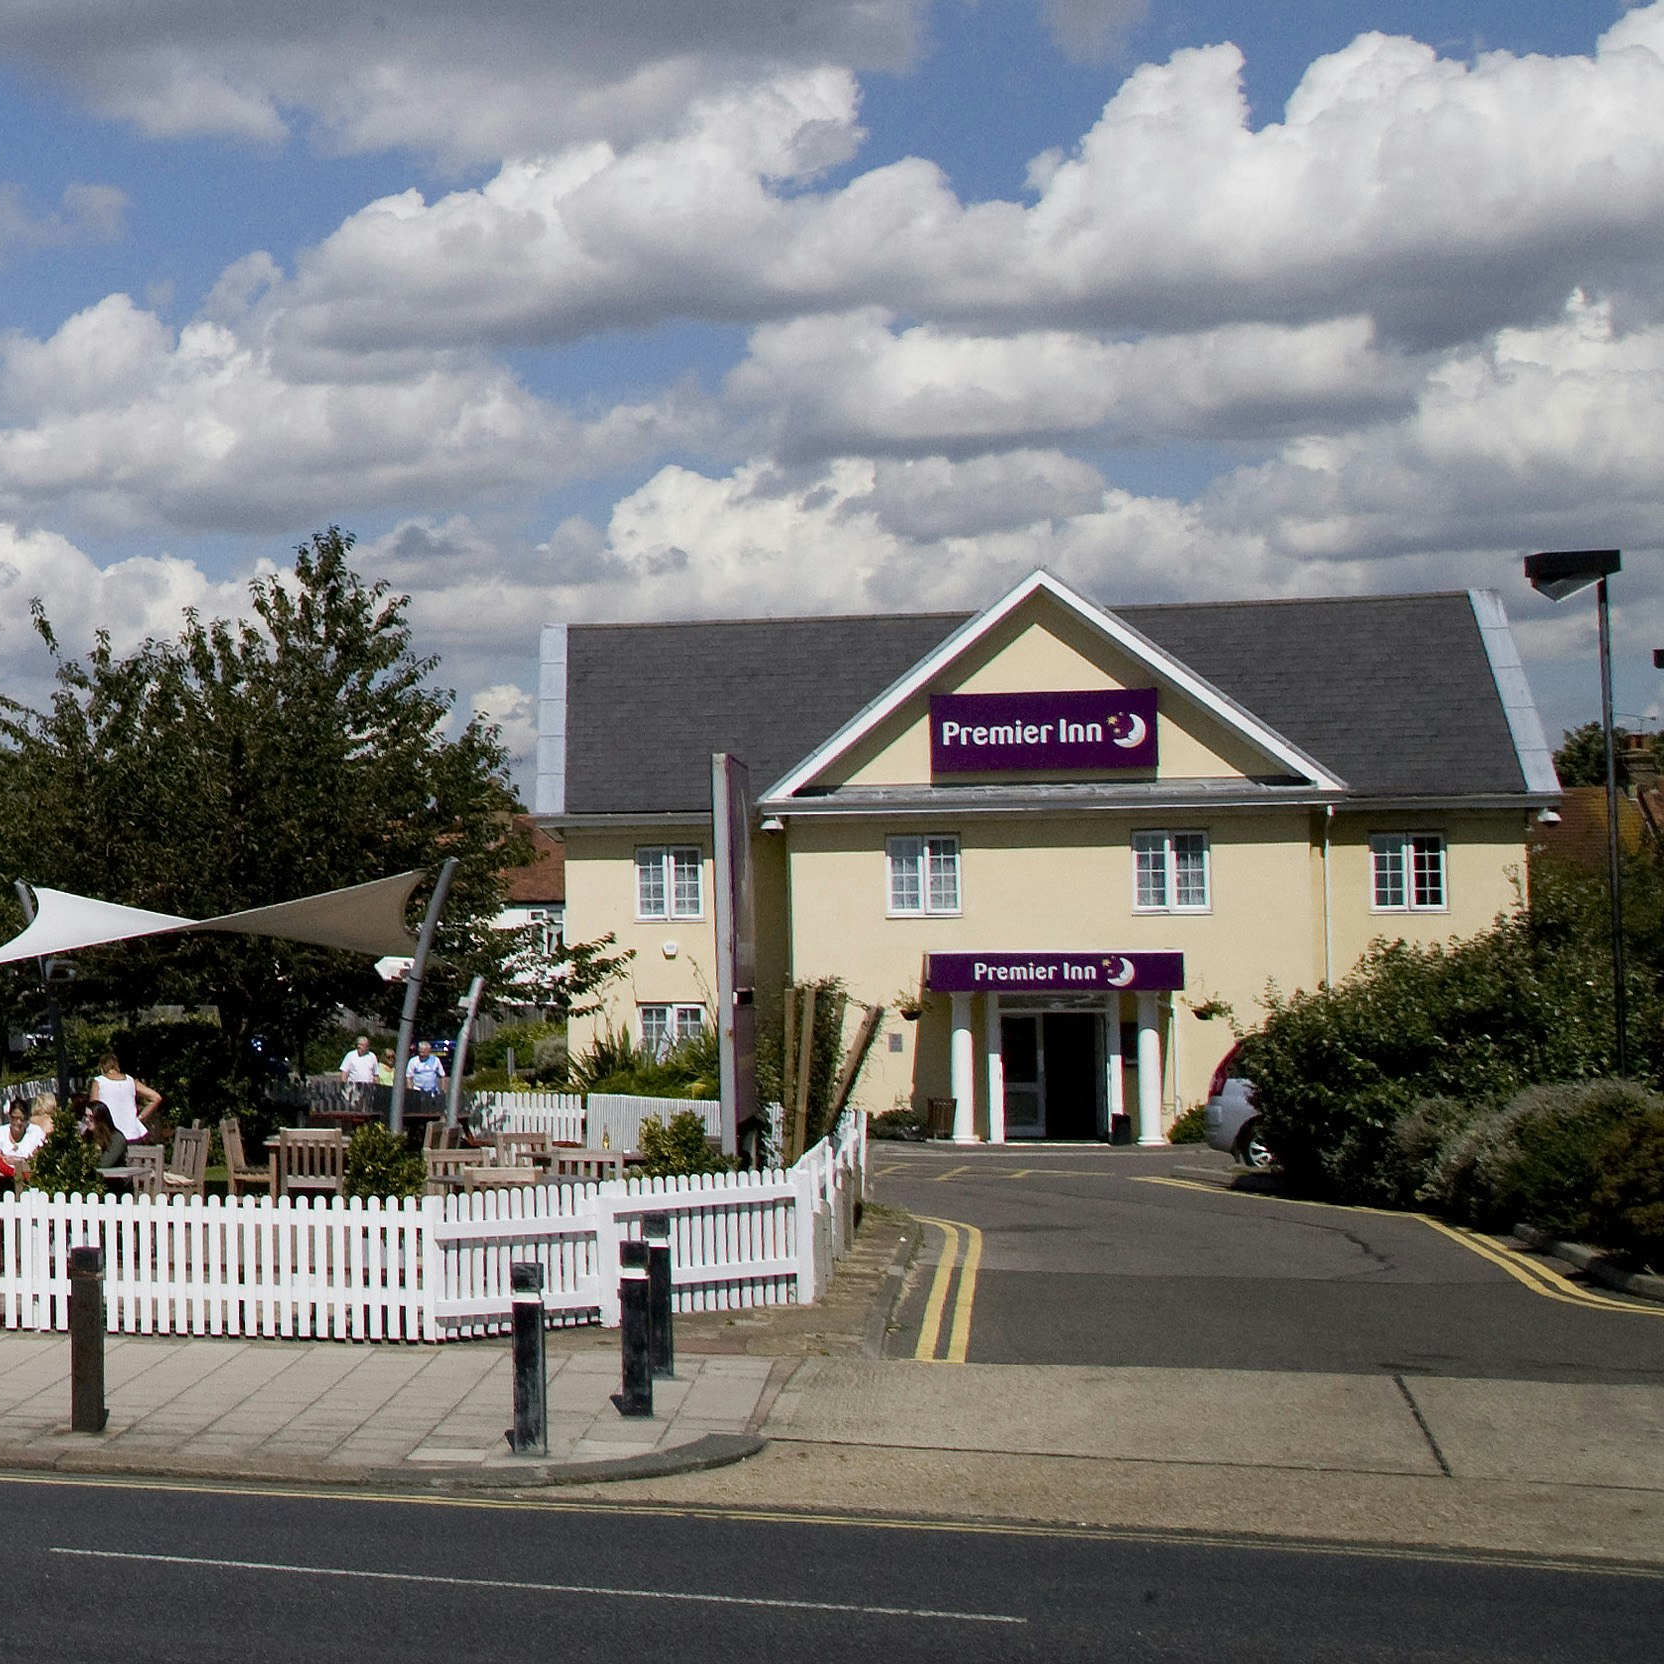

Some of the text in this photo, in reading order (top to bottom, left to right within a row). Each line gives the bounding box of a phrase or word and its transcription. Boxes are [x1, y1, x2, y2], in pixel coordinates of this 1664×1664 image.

[942, 718, 1102, 746] Premier Inn
[974, 961, 1097, 981] Premier Inn
